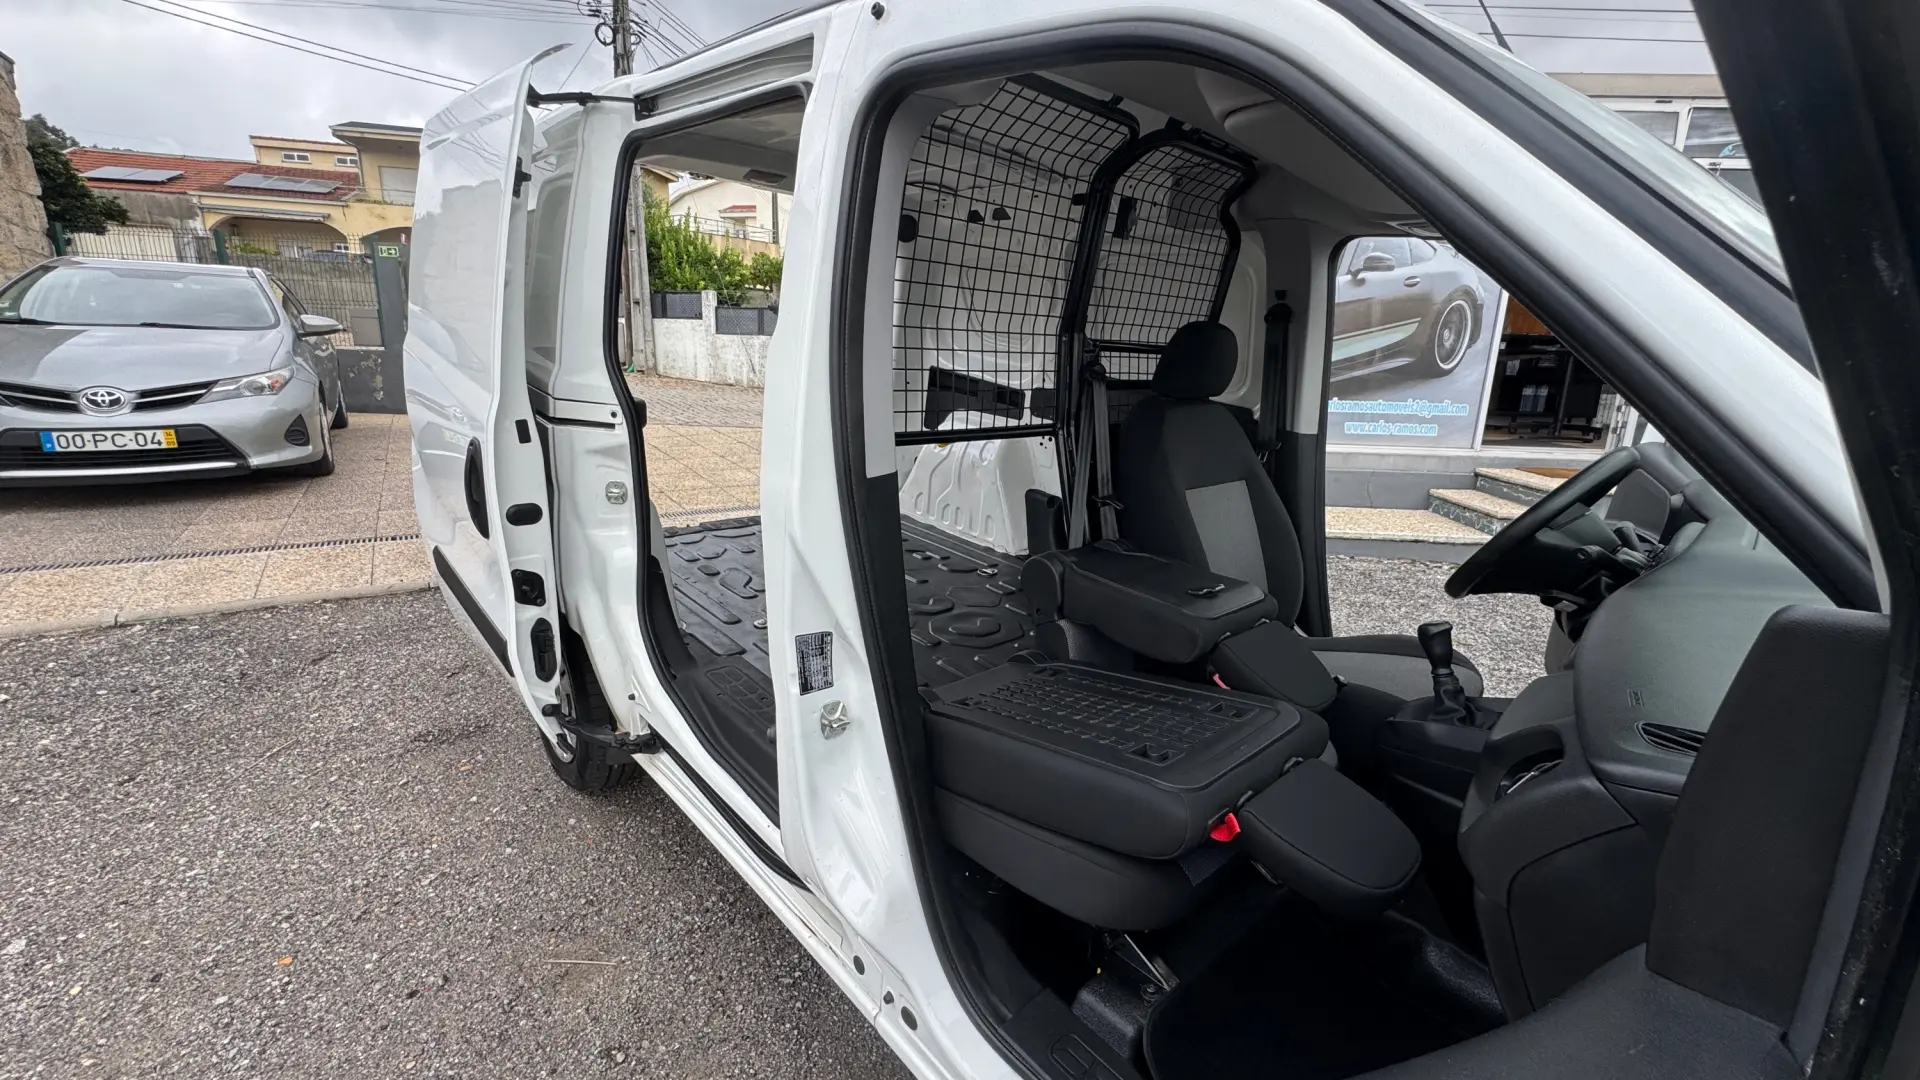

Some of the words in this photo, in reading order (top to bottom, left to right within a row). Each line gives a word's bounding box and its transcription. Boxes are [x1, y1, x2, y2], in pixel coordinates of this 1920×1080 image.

[1328, 397, 1469, 417] rlosramosautomoveis2@gmail.com
[1344, 420, 1438, 436] www.carlos-ramos.com
[56, 432, 163, 449] 00-PC-04
